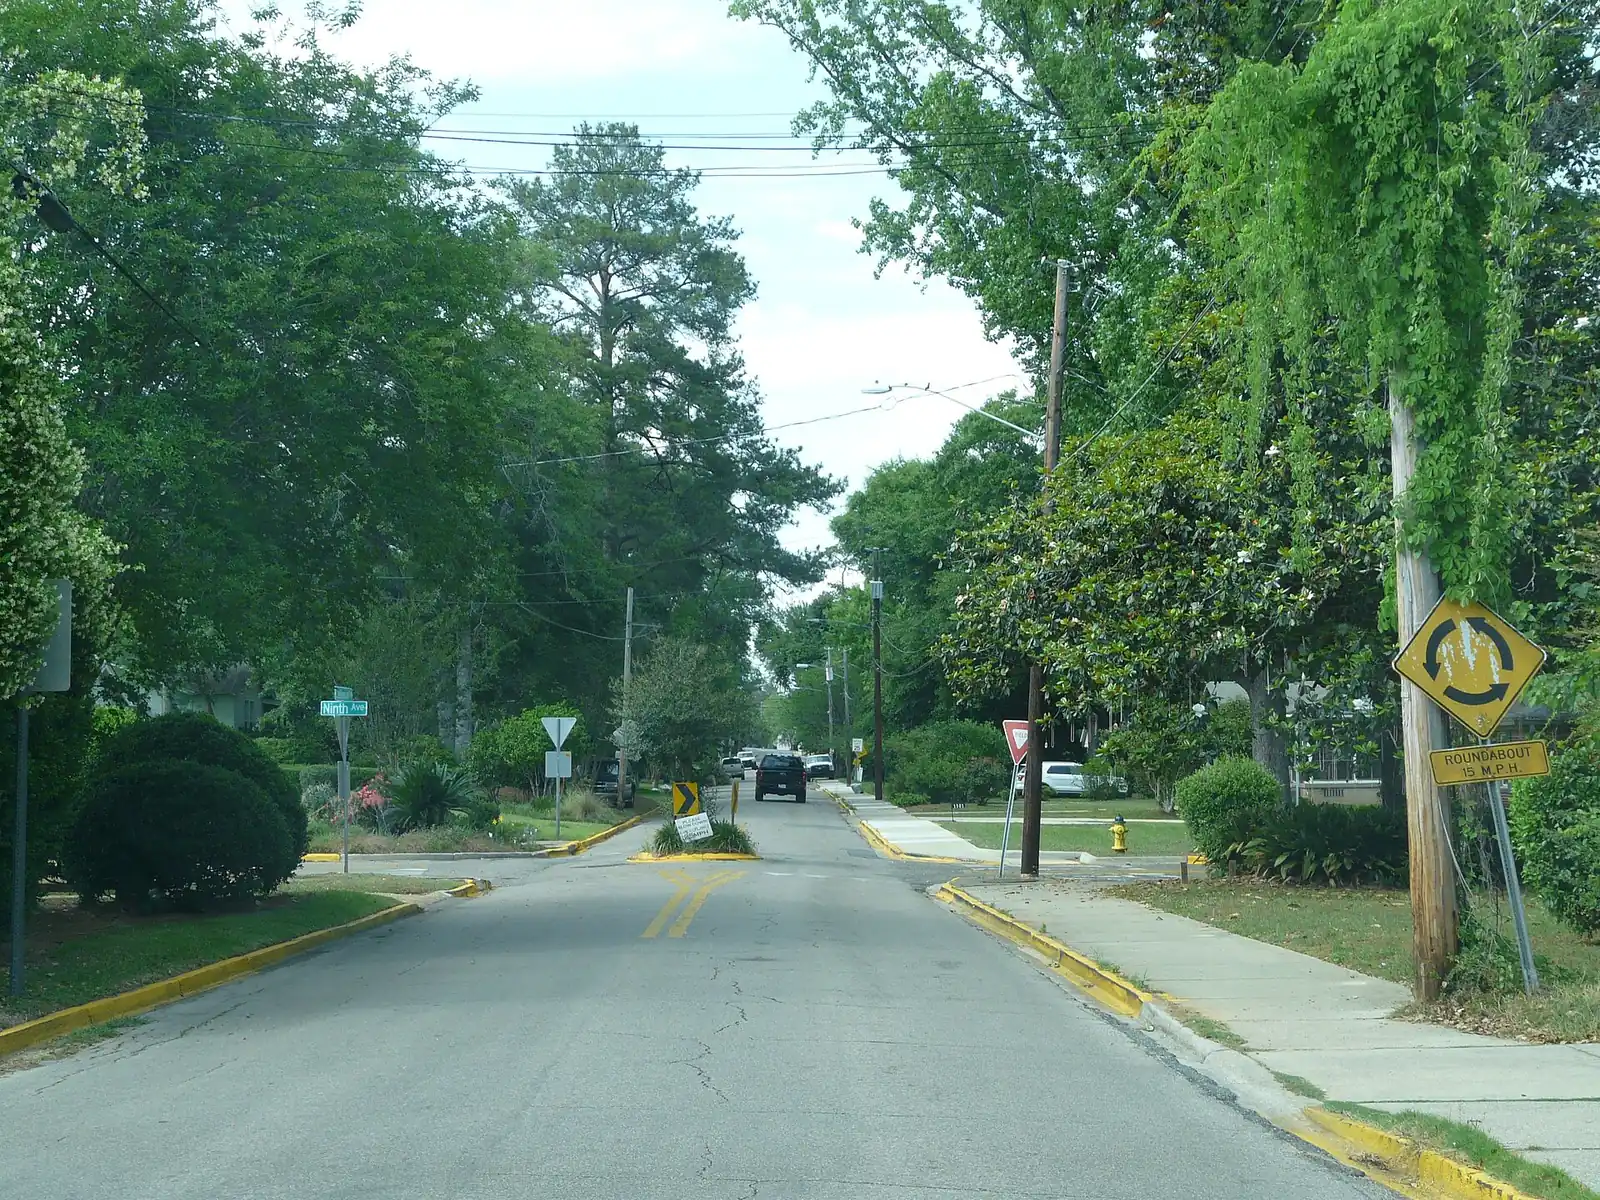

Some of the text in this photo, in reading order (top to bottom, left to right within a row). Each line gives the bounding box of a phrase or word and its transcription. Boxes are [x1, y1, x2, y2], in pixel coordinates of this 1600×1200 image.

[323, 703, 365, 714] Ninth Ave
[1444, 746, 1532, 765] ROUNDABOUT
[1462, 763, 1523, 777] 15 M.P.H.
